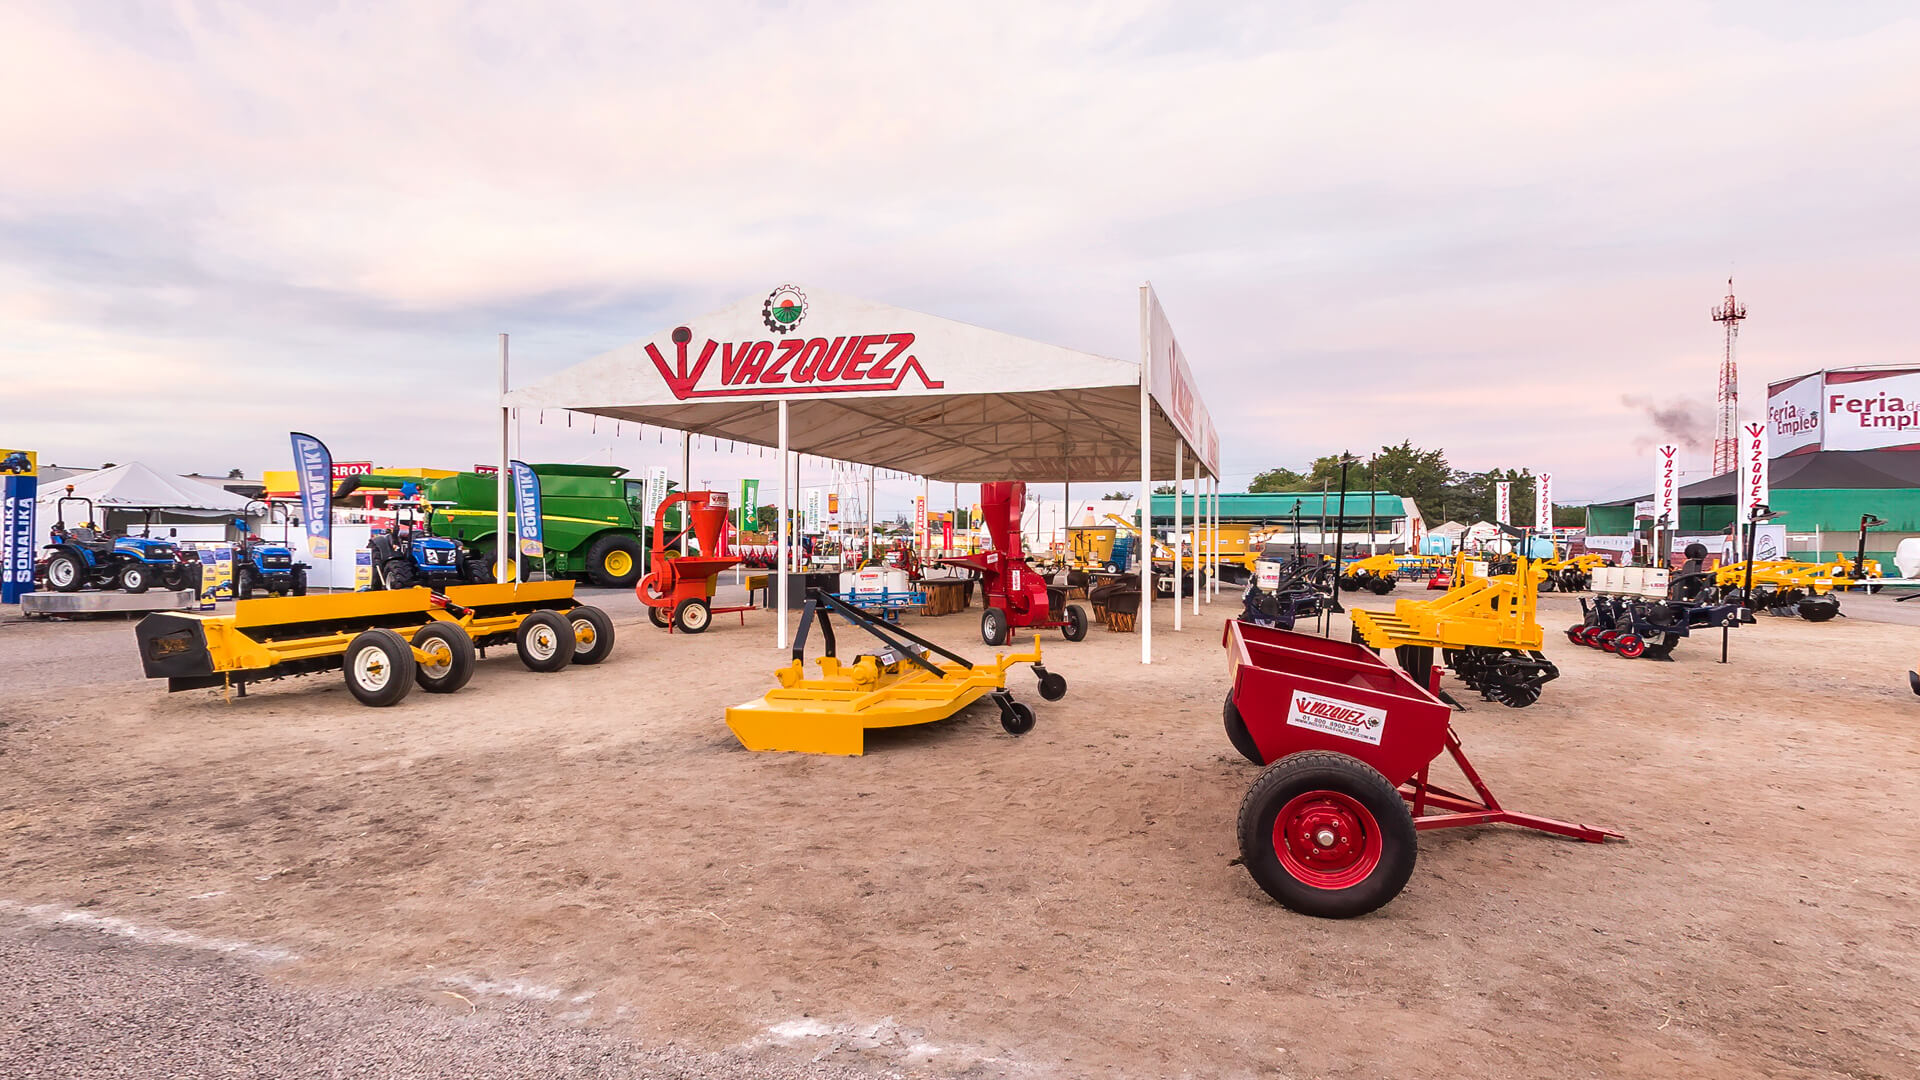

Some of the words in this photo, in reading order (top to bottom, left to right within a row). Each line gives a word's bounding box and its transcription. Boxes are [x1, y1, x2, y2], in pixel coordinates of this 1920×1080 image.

[721, 332, 916, 386] VAZQUEZ
[1769, 400, 1796, 422] Feria
[1829, 391, 1905, 414] Feria
[1777, 415, 1818, 436] Empleo
[1744, 423, 1765, 508] VAZQUEZ
[3, 497, 15, 582] SONALIKA
[17, 498, 33, 582] SONALIKA
[1309, 701, 1366, 723] VAZQUEZ
